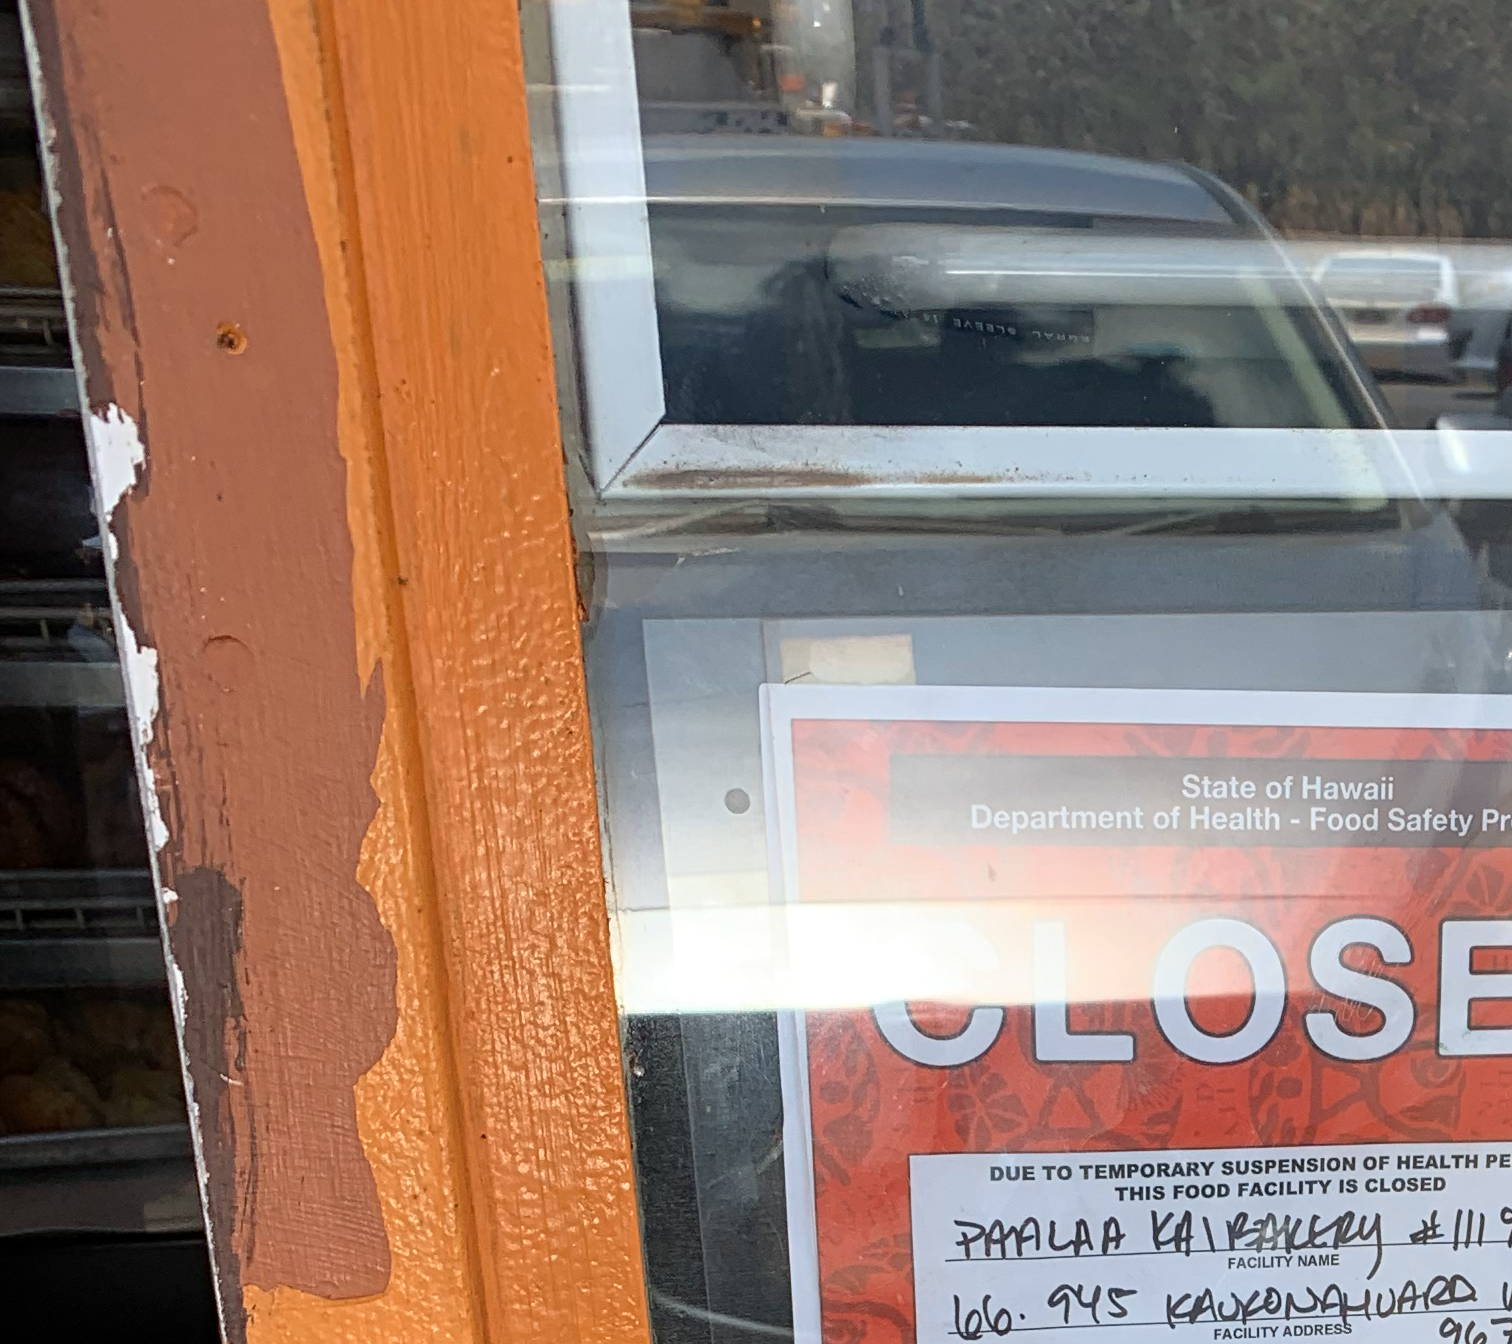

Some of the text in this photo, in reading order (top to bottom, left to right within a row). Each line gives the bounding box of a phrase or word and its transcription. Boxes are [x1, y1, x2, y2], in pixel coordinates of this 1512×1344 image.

[1182, 774, 1393, 800] State of Hawaii
[971, 805, 1143, 834] Department
[1154, 806, 1180, 830] of
[1190, 806, 1280, 830] Health
[1310, 808, 1378, 831] Food
[1388, 808, 1473, 836] Safety
[990, 1165, 1035, 1181] DUE
[1042, 1165, 1072, 1180] TO
[1079, 1162, 1213, 1180] TEMPORARY
[1221, 1156, 1356, 1175] SUSPENSION
[1363, 1155, 1389, 1170] OF
[1397, 1154, 1478, 1170] HEALTH
[1115, 1177, 1446, 1201] THIS FOOD FACILITY IS CLOSED
[954, 1216, 1125, 1259] PAALAA
[1228, 1254, 1340, 1269] FACILITY NAME
[1048, 1284, 1137, 1324] 945
[1214, 1323, 1352, 1340] FACILITY ADDRESS
